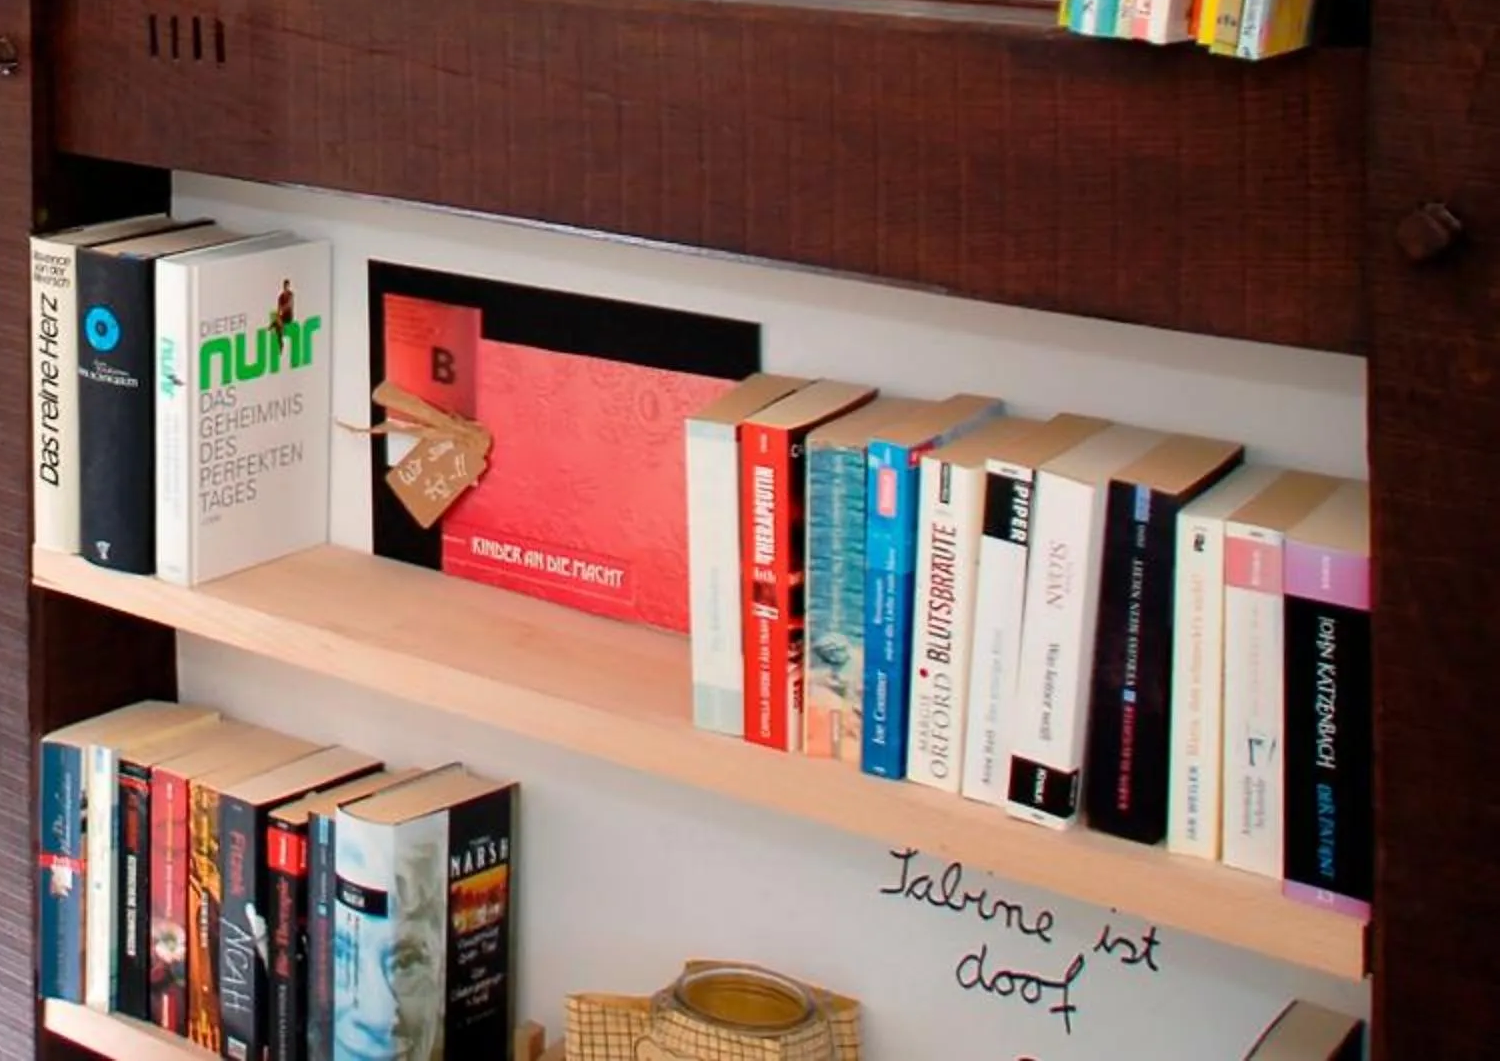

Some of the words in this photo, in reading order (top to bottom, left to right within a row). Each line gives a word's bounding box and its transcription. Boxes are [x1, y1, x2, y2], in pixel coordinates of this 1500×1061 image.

[39, 291, 59, 359] Herz
[200, 313, 248, 336] DIETER
[431, 347, 456, 385] B
[42, 362, 60, 434] reine
[200, 386, 237, 414] DAS
[200, 393, 304, 438] GEHEIMNIS
[39, 439, 60, 487] Das
[200, 438, 238, 465] DES
[200, 443, 304, 489] PERFEKTEN
[200, 479, 257, 514] TAGES
[1010, 479, 1030, 542] PIPER
[472, 536, 522, 564] KINDER
[547, 555, 571, 577] DIE
[572, 560, 623, 588] MACHT
[1316, 616, 1336, 657] JOHN
[930, 673, 952, 780] ORFORD
[1315, 659, 1338, 771] KATZENBACH
[1093, 907, 1160, 972] ist
[955, 943, 1085, 1035] doof
